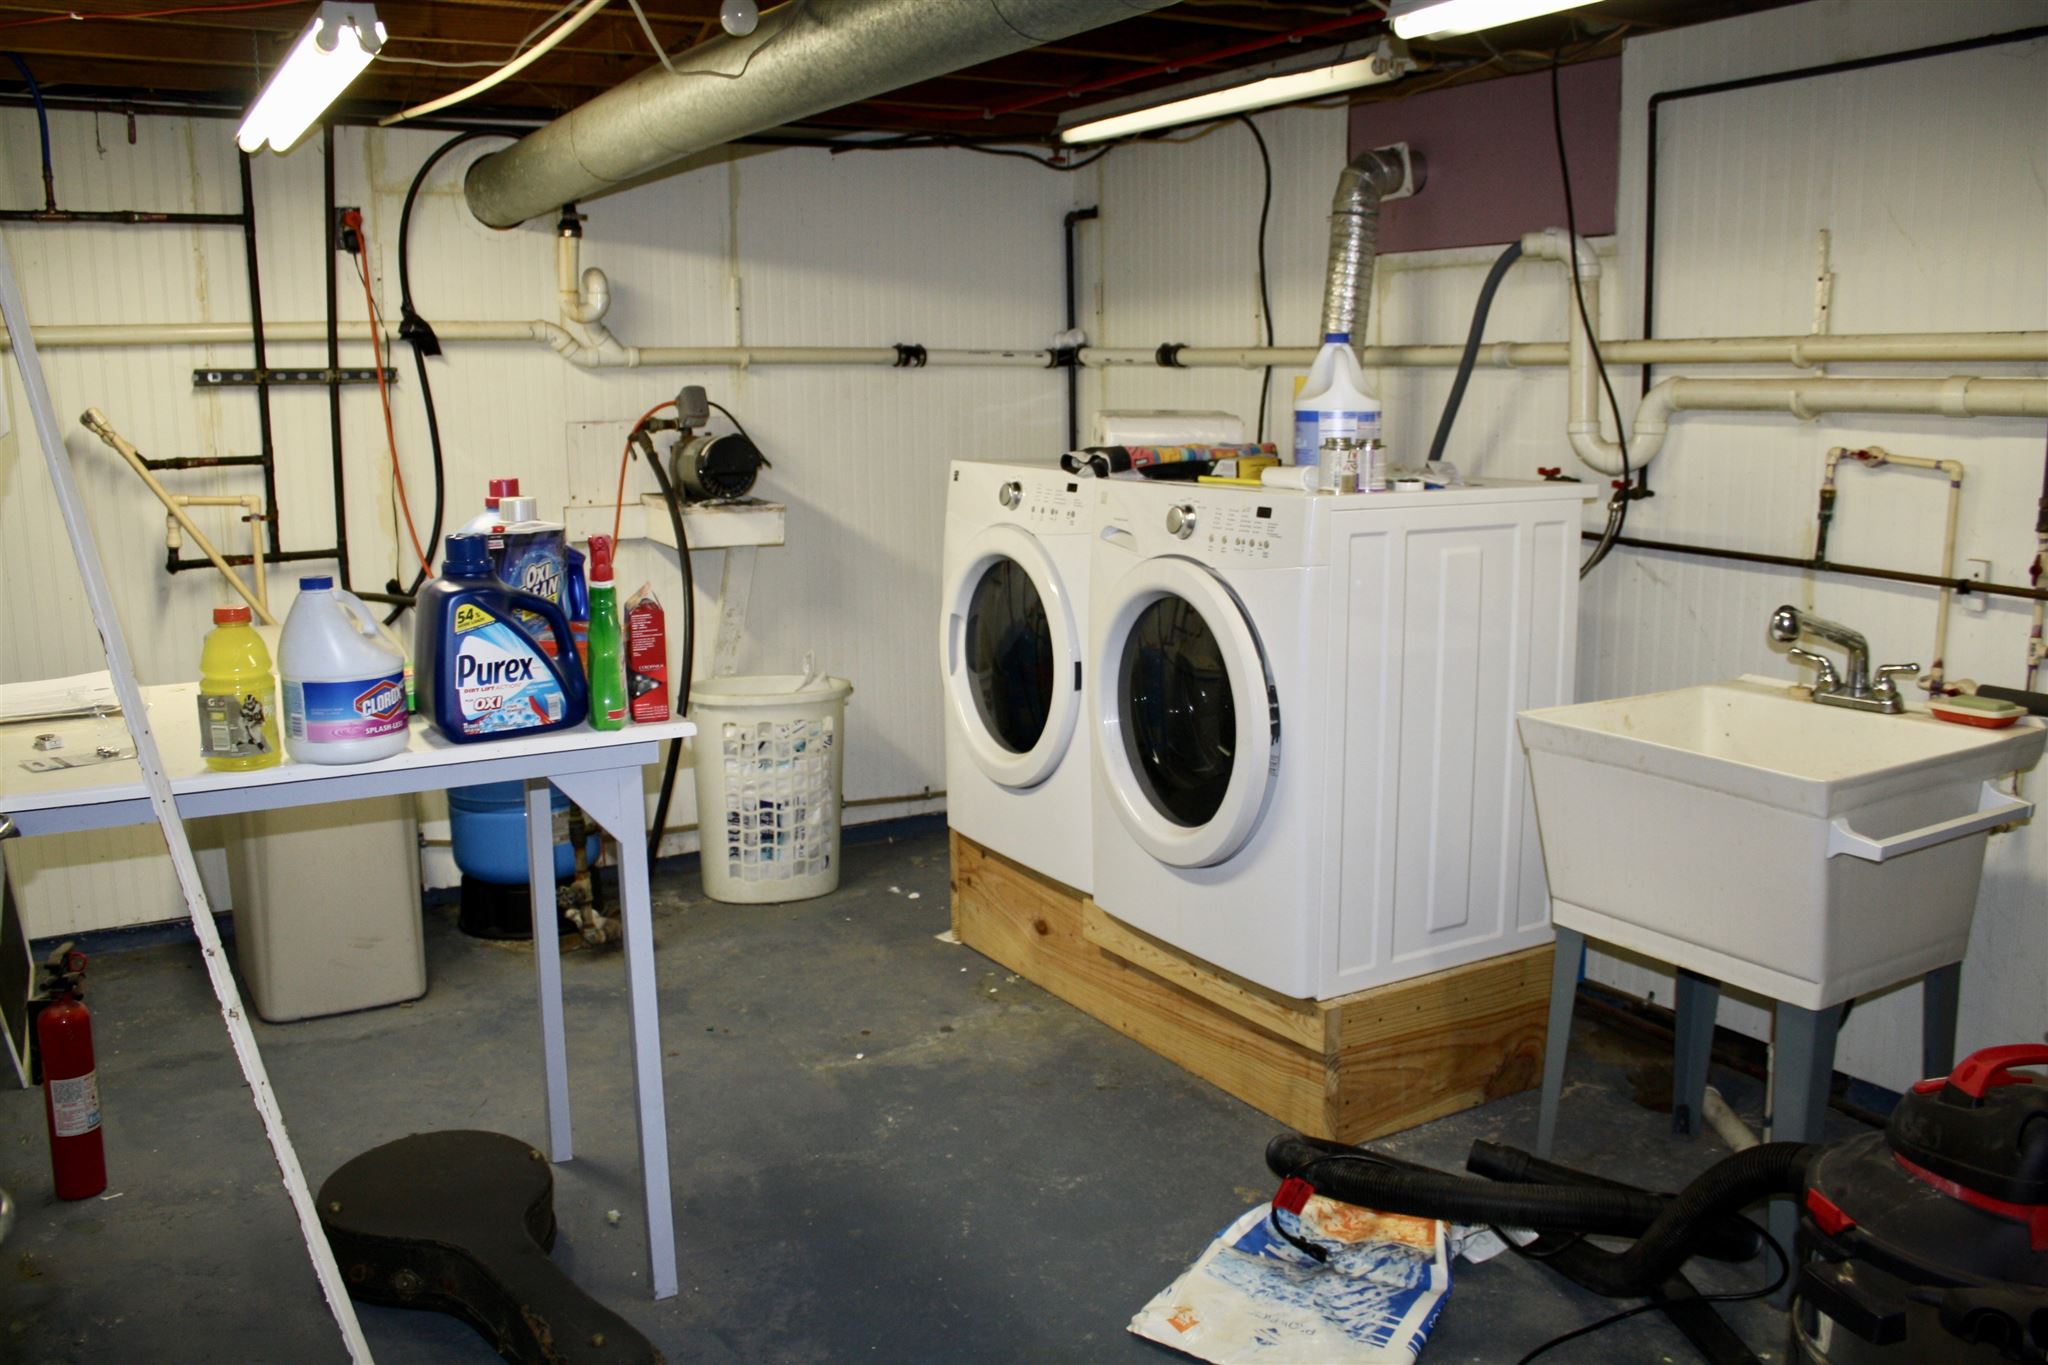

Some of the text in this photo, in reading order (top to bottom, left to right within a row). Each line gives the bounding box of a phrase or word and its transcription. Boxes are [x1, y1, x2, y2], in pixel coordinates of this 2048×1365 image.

[526, 563, 550, 588] OXI
[457, 608, 473, 624] 54
[457, 654, 534, 688] Purex
[361, 686, 402, 717] CLOROX
[474, 695, 503, 711] OXI
